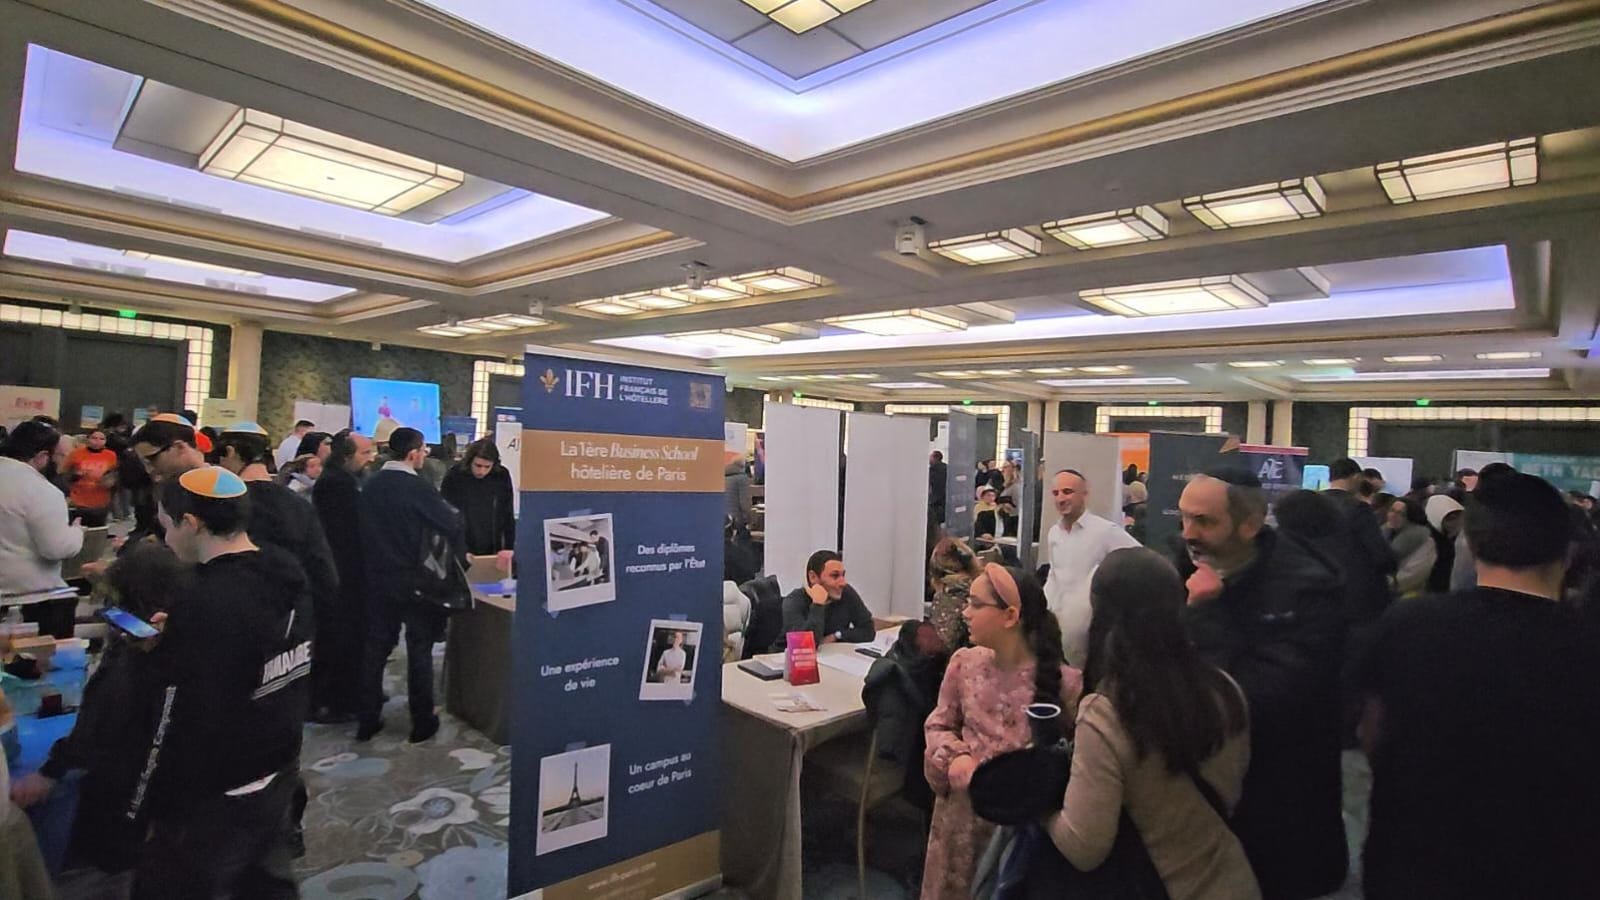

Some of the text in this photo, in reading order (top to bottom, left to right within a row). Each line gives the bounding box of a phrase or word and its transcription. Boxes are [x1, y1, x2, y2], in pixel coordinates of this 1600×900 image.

[565, 369, 614, 400] IFH
[619, 376, 654, 385] INSTITUT
[619, 384, 668, 396] FRANÇAIS DE
[619, 394, 668, 405] L'HÔTELLERIE
[561, 441, 698, 461] La 1ère Business School
[571, 463, 686, 481] hôtelière de Paris
[637, 543, 695, 557] Des diplômes
[626, 556, 706, 574] reconnus par l'État
[540, 654, 620, 676] Une expérience
[564, 678, 596, 691] de vie
[629, 752, 692, 776] Un campus au
[657, 776, 669, 786] de
[671, 768, 692, 782] Paris
